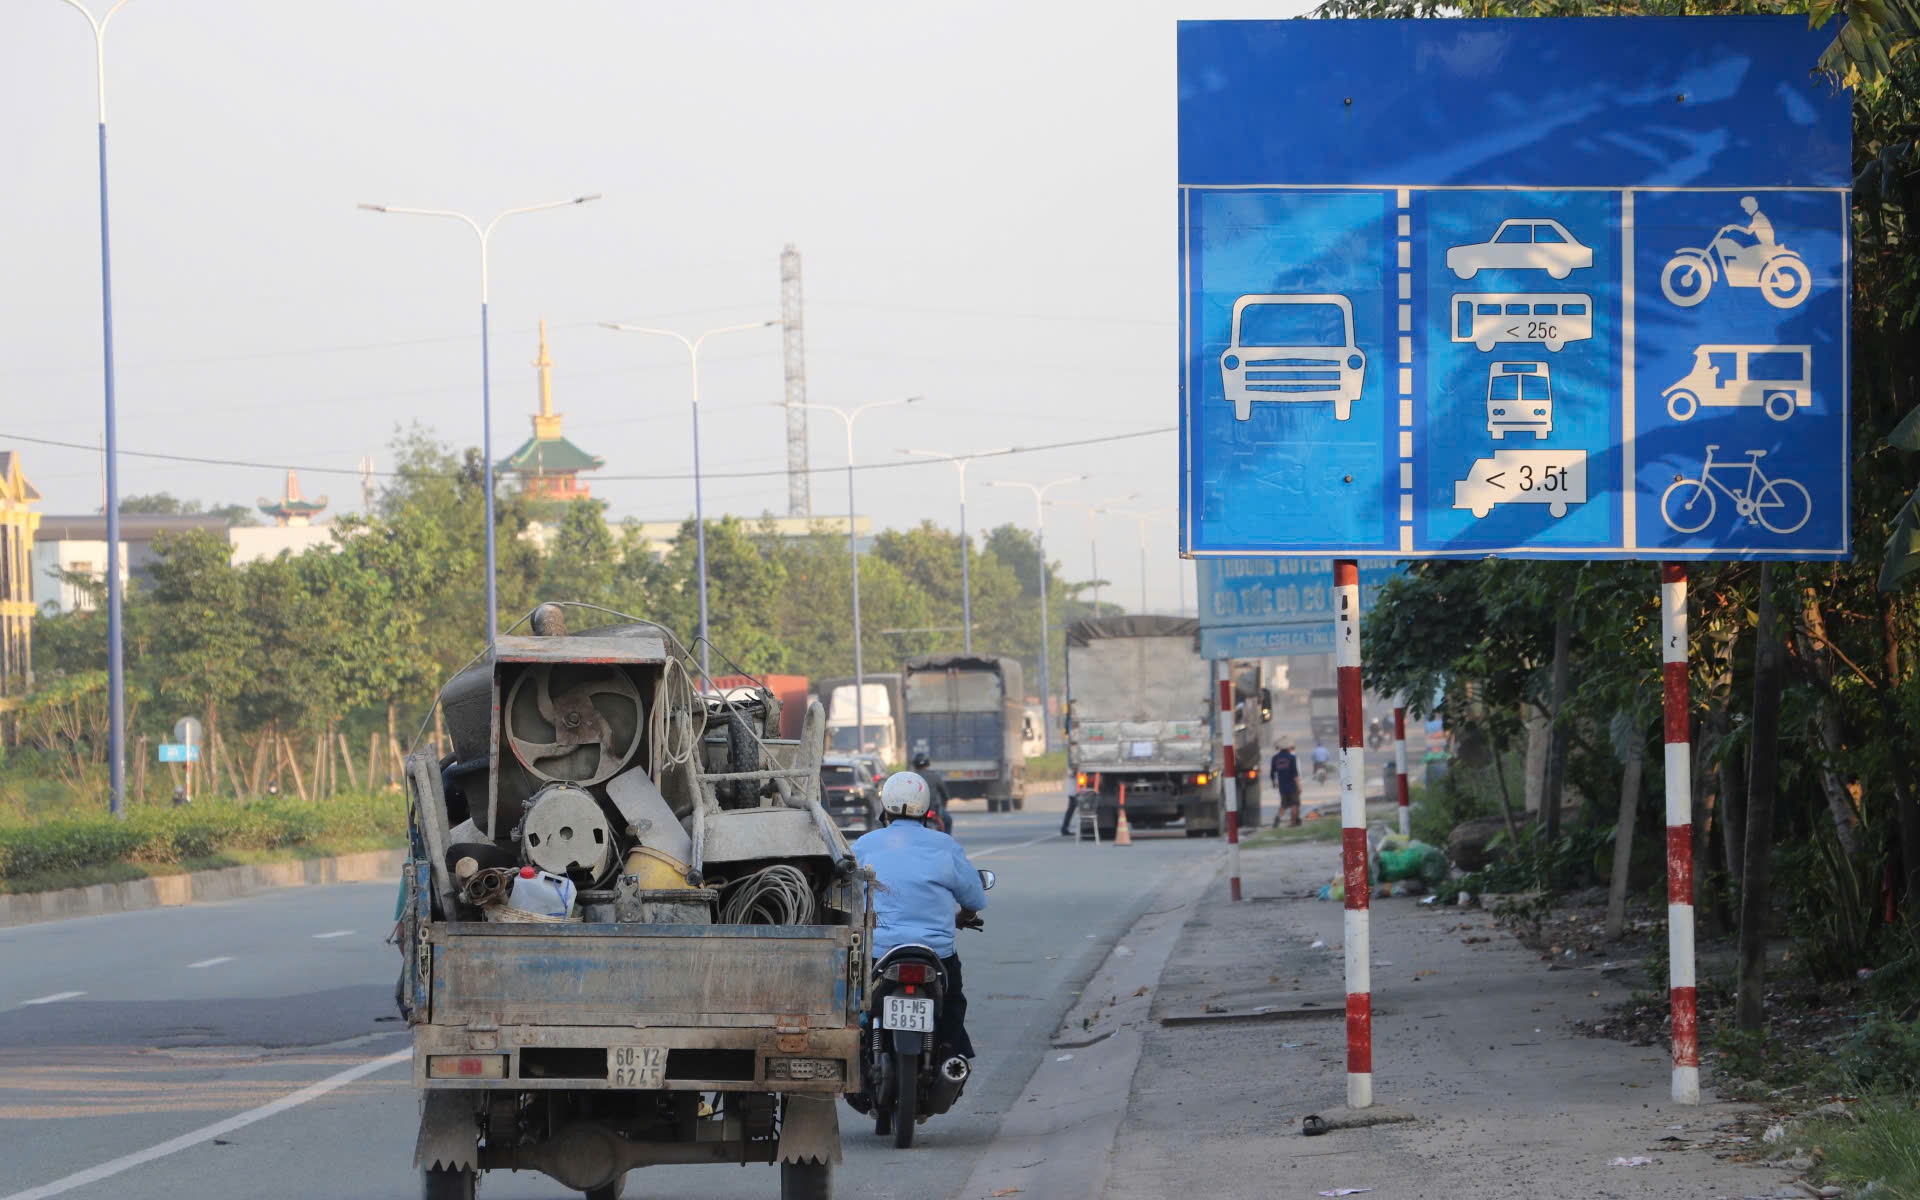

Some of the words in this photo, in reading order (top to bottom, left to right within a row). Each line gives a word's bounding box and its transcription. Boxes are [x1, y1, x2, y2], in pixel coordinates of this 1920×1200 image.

[1506, 326, 1520, 338] <
[1527, 322, 1557, 339] 25c
[1485, 472, 1506, 489] <
[1519, 465, 1568, 491] 3.5t
[891, 999, 926, 1014] 61-N5
[891, 1014, 925, 1029] 5851
[616, 1047, 660, 1066] 60-Y2
[616, 1069, 660, 1087] 6245
